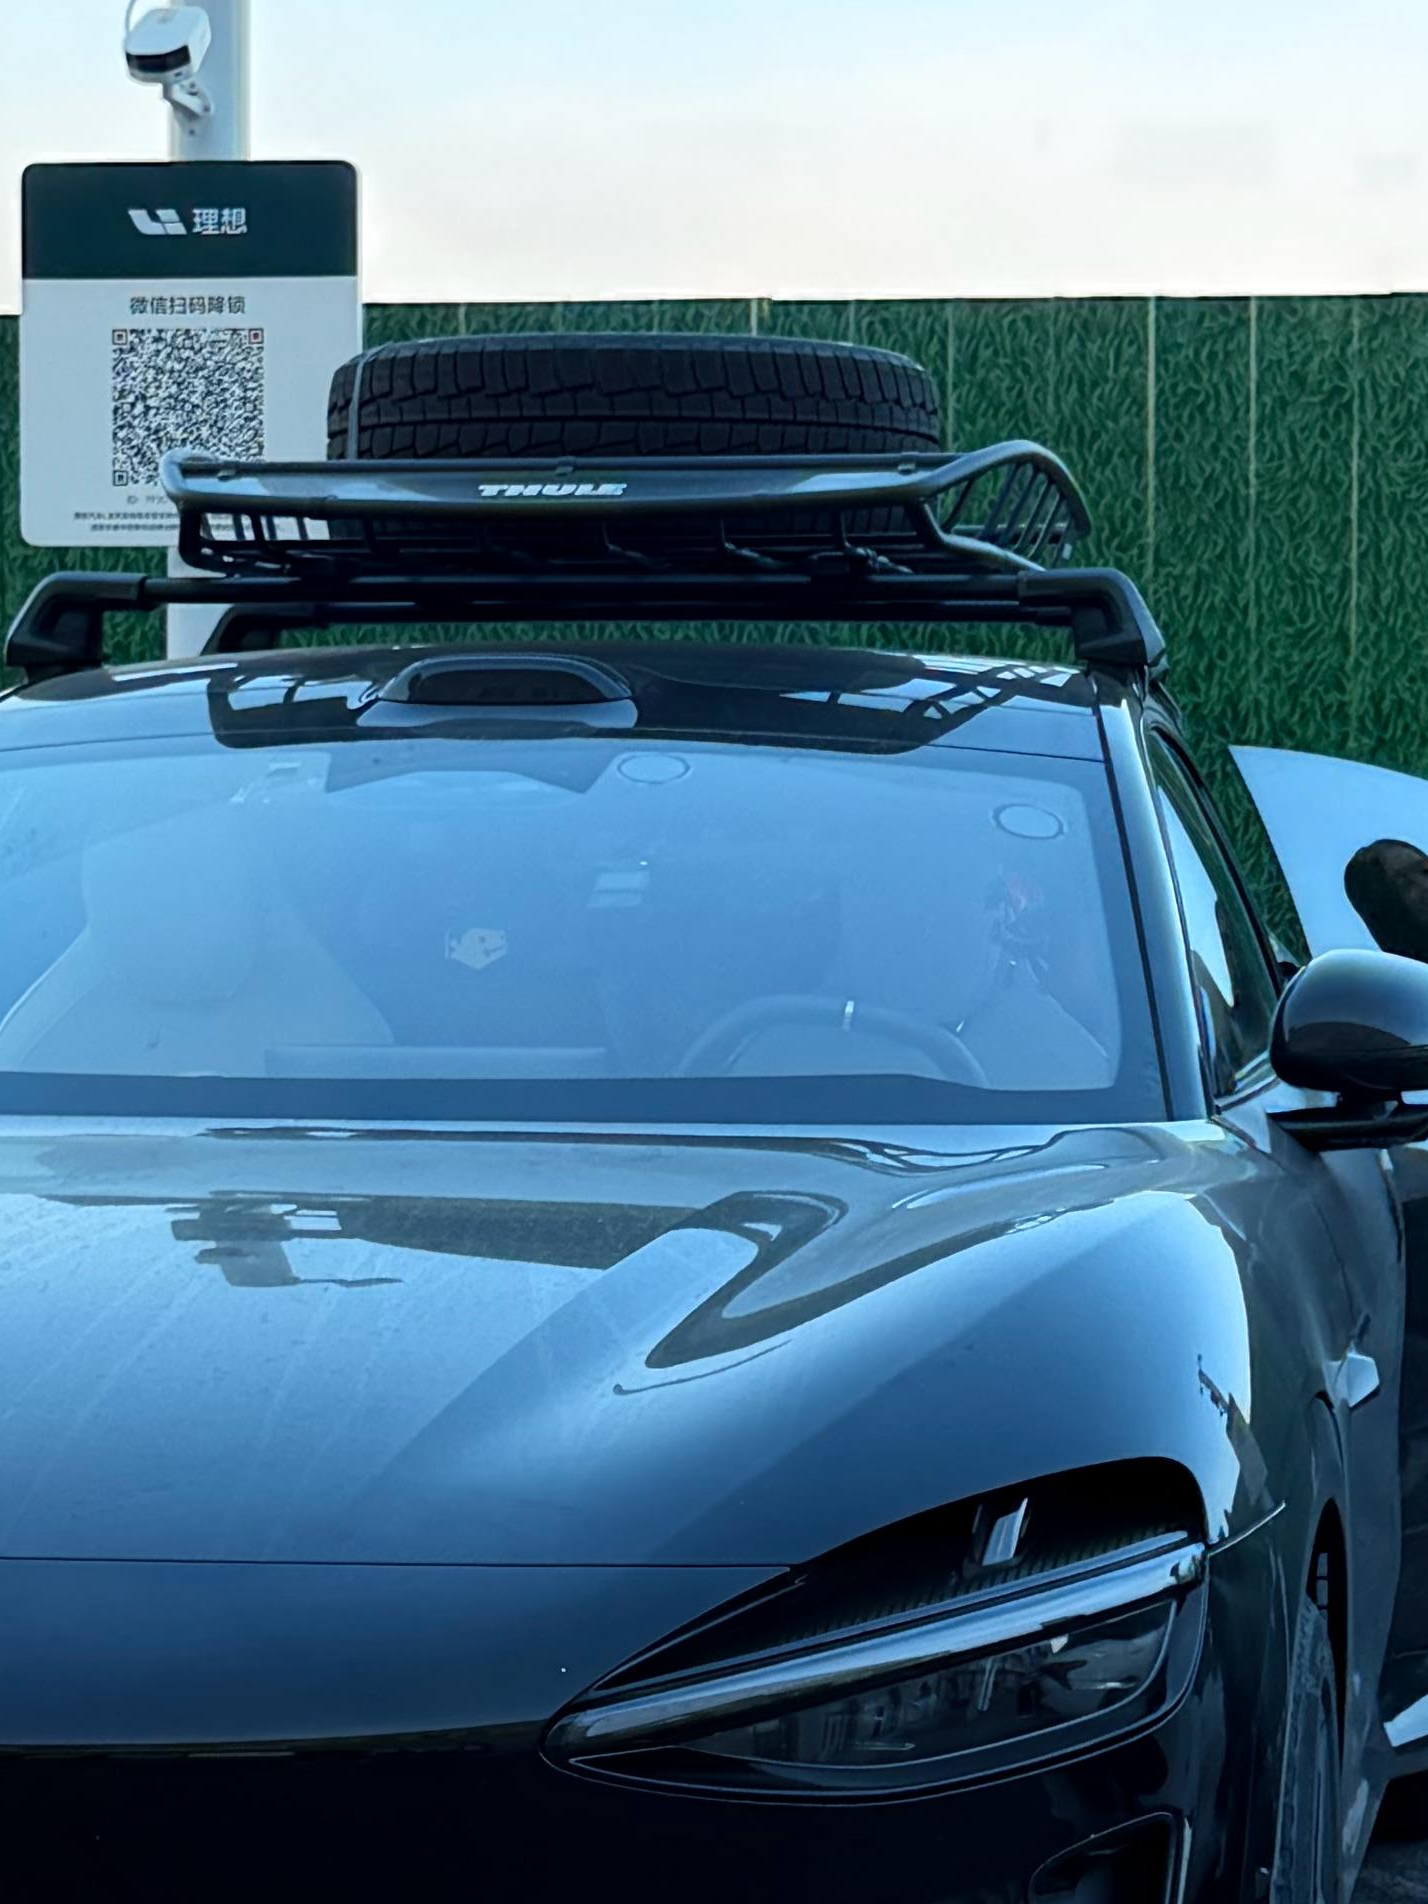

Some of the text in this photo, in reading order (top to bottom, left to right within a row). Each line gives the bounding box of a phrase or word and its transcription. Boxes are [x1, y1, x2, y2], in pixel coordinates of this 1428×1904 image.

[191, 207, 248, 236] 理想
[129, 295, 246, 316] 微信扫码降锁
[477, 483, 628, 497] THULE
